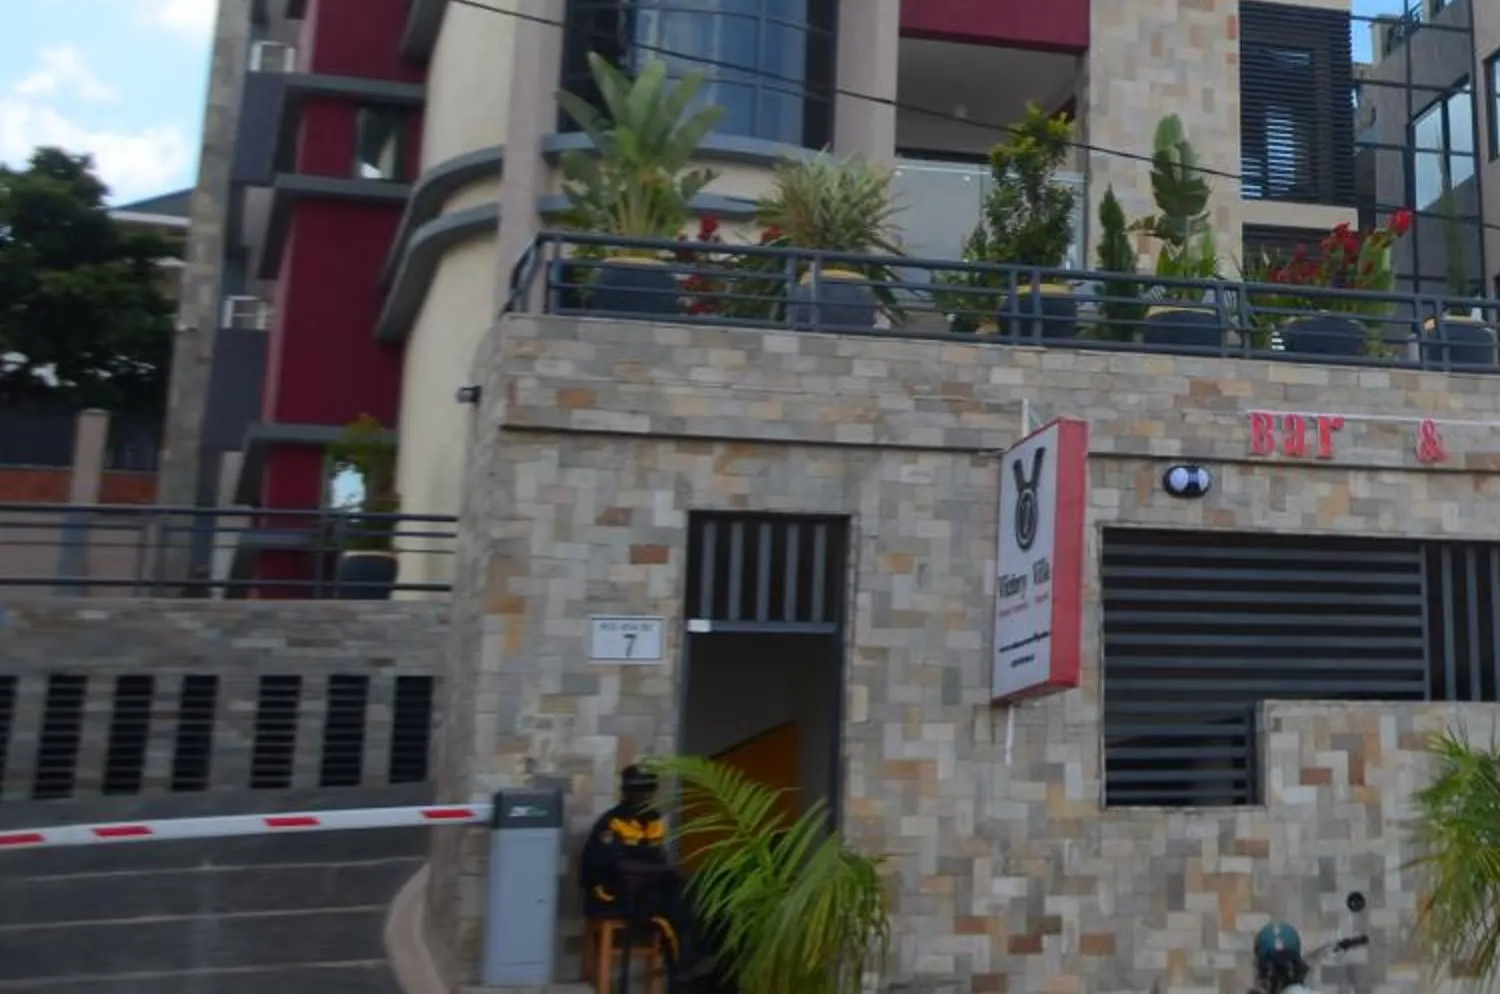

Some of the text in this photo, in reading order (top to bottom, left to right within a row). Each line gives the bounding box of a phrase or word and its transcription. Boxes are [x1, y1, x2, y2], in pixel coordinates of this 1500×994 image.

[1249, 411, 1344, 459] Bar
[1415, 416, 1447, 463] &
[623, 633, 637, 657] 7
